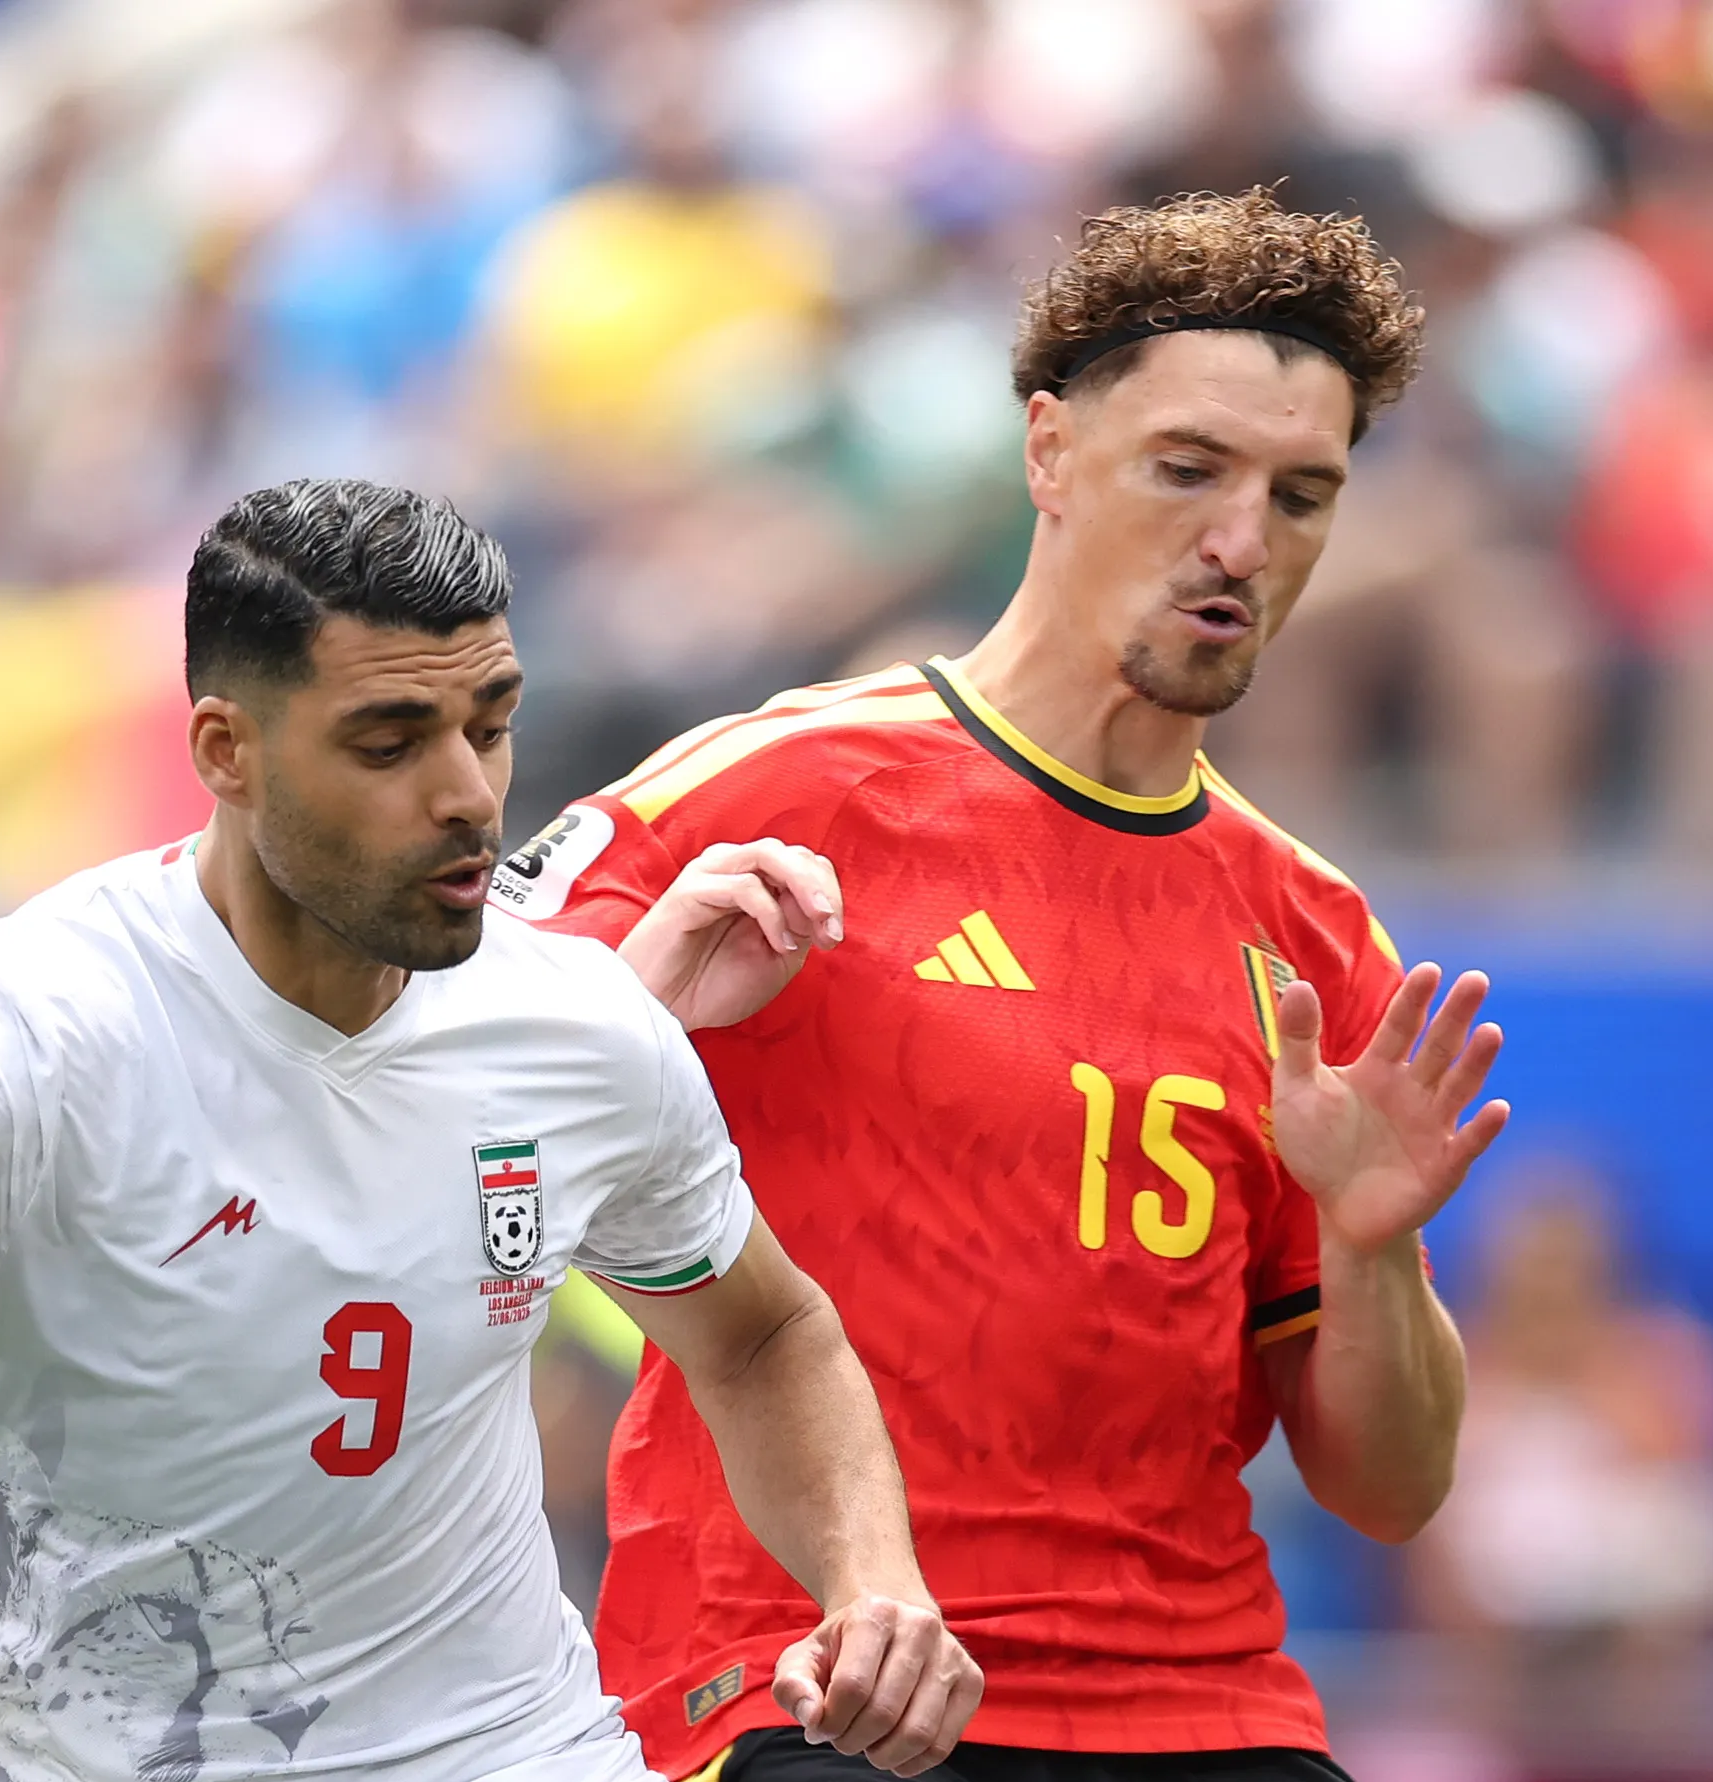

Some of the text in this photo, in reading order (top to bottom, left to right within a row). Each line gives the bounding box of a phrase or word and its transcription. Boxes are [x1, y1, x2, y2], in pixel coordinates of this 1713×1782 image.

[490, 877, 528, 905] 026
[1069, 1061, 1227, 1260] 15
[488, 1291, 533, 1312] LOS ANGELES
[310, 1301, 413, 1477] 9
